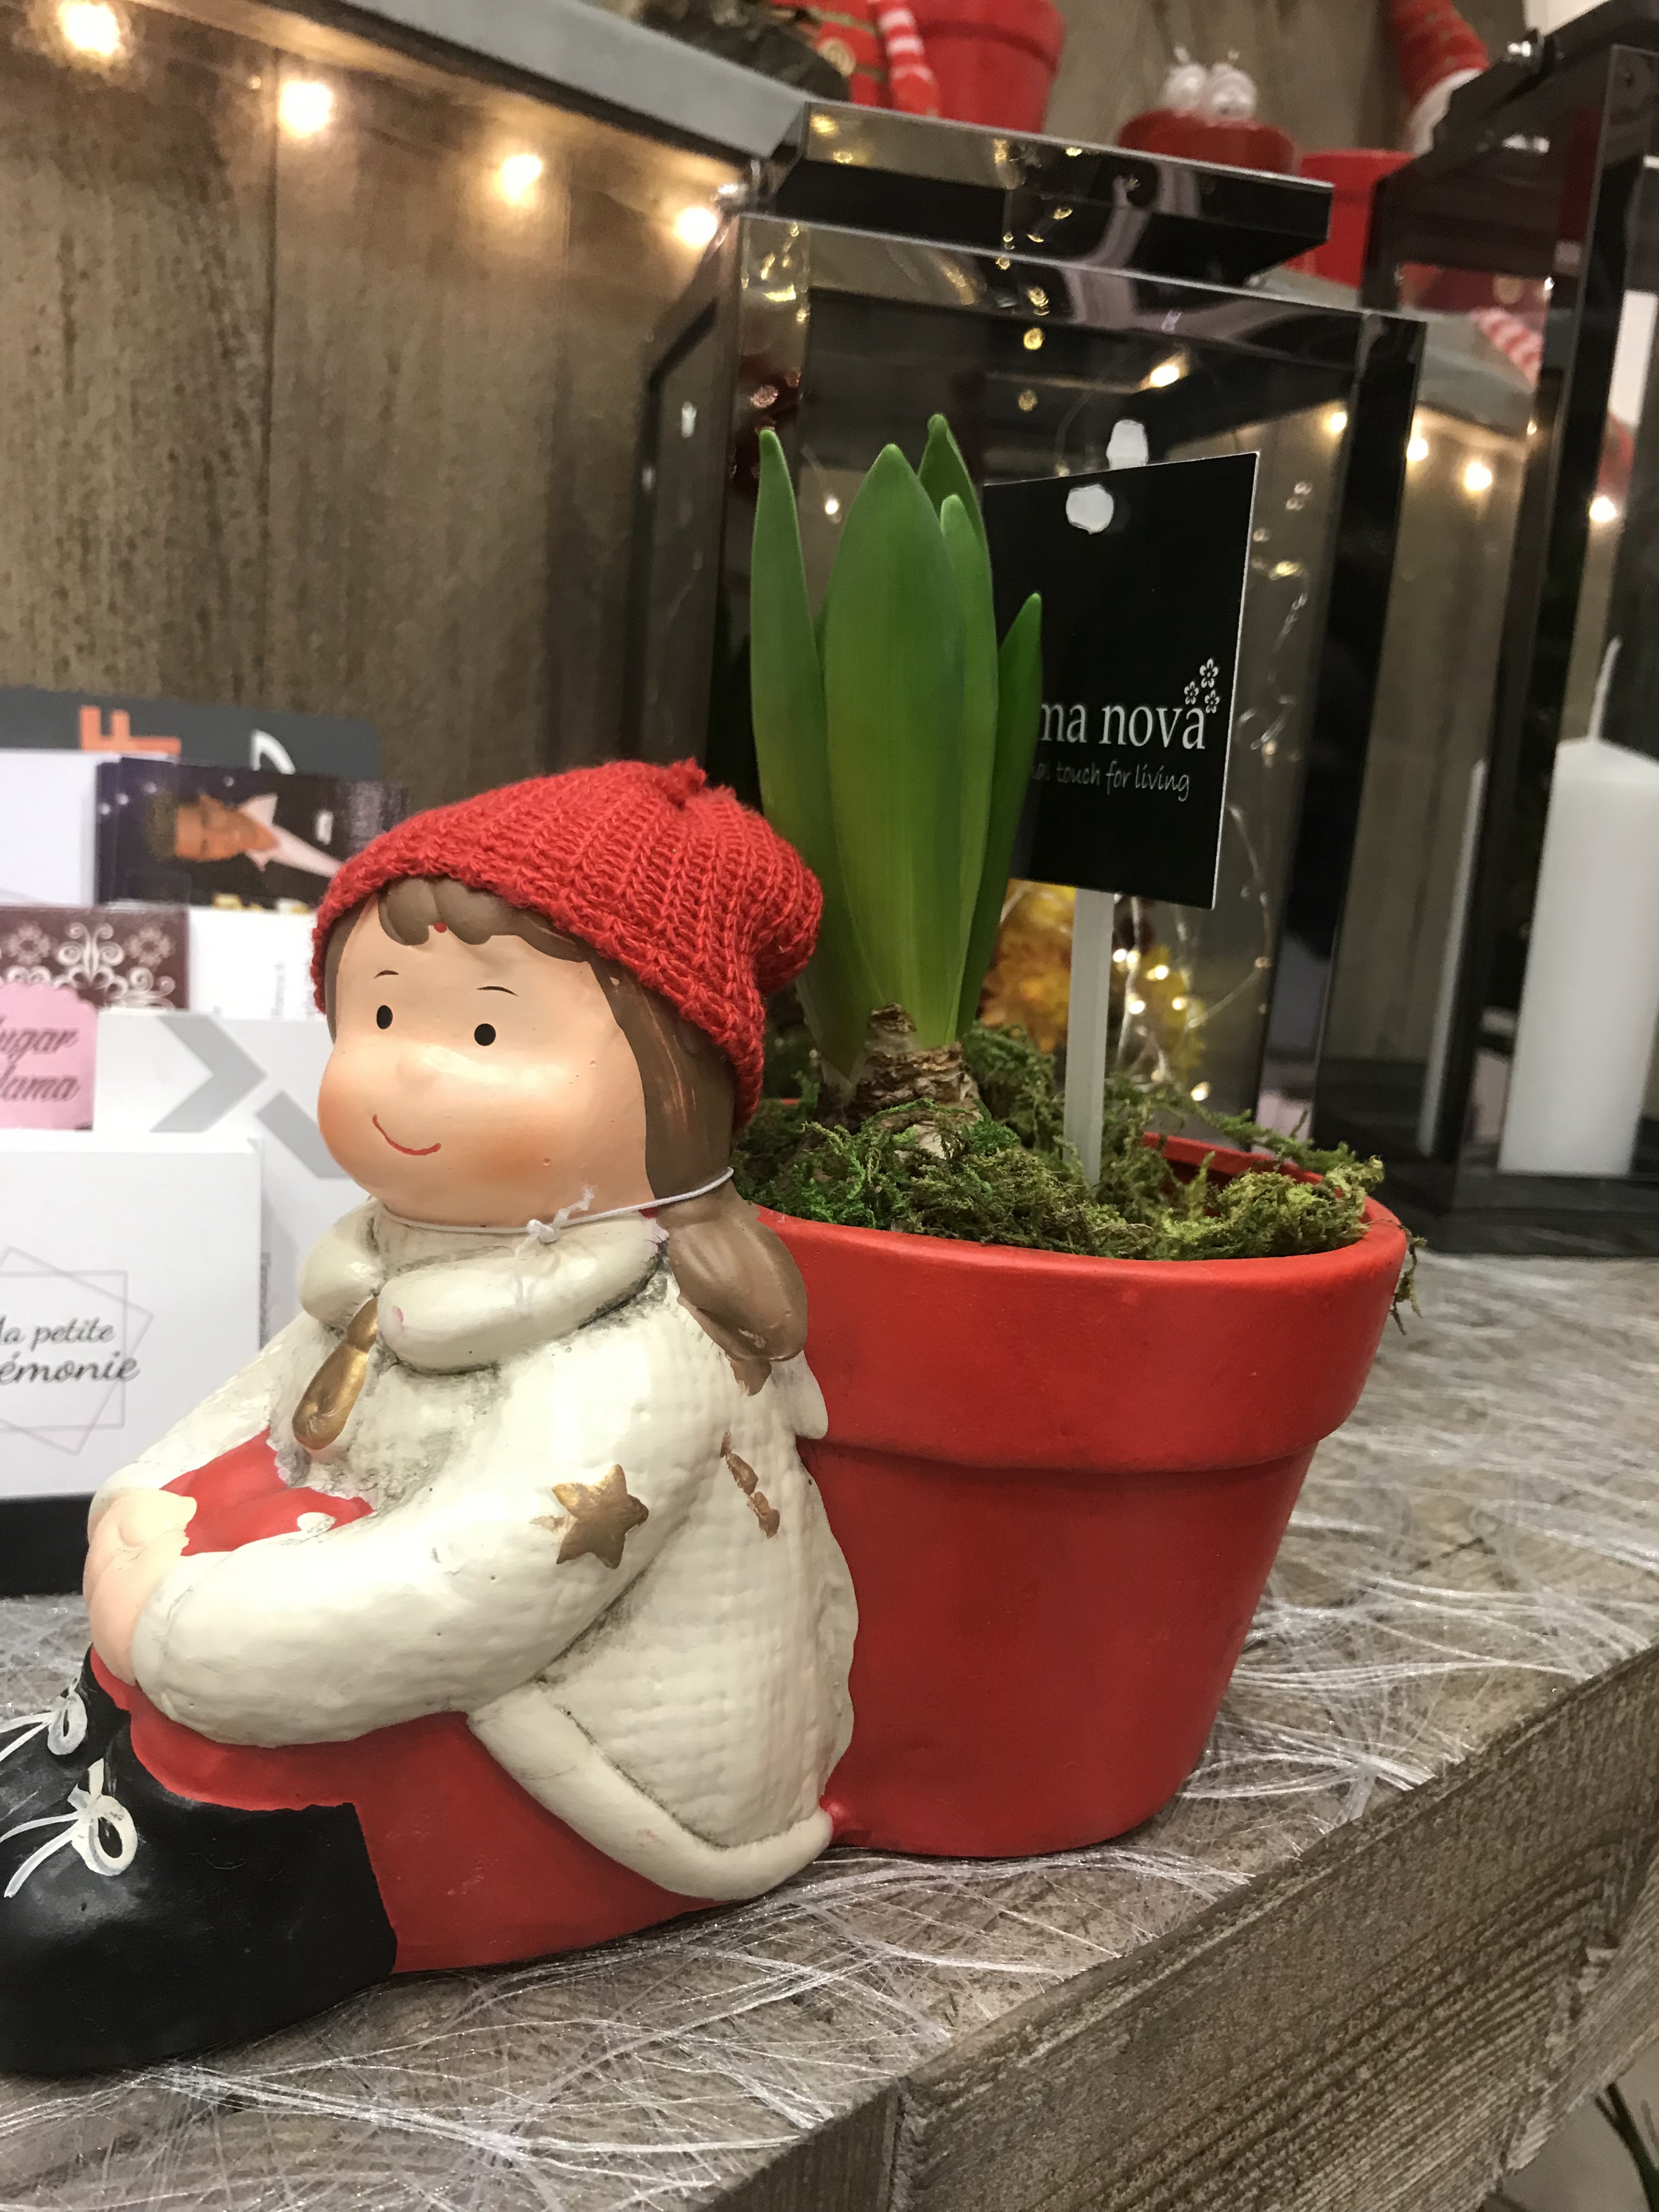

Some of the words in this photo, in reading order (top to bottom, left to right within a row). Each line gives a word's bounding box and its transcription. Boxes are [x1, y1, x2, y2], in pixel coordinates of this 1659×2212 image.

[1098, 704, 1205, 750] nova
[1057, 761, 1100, 786] touch
[1105, 759, 1132, 795] for
[1135, 764, 1189, 802] living
[0, 1017, 79, 1064] ugar
[30, 1317, 116, 1352] petite
